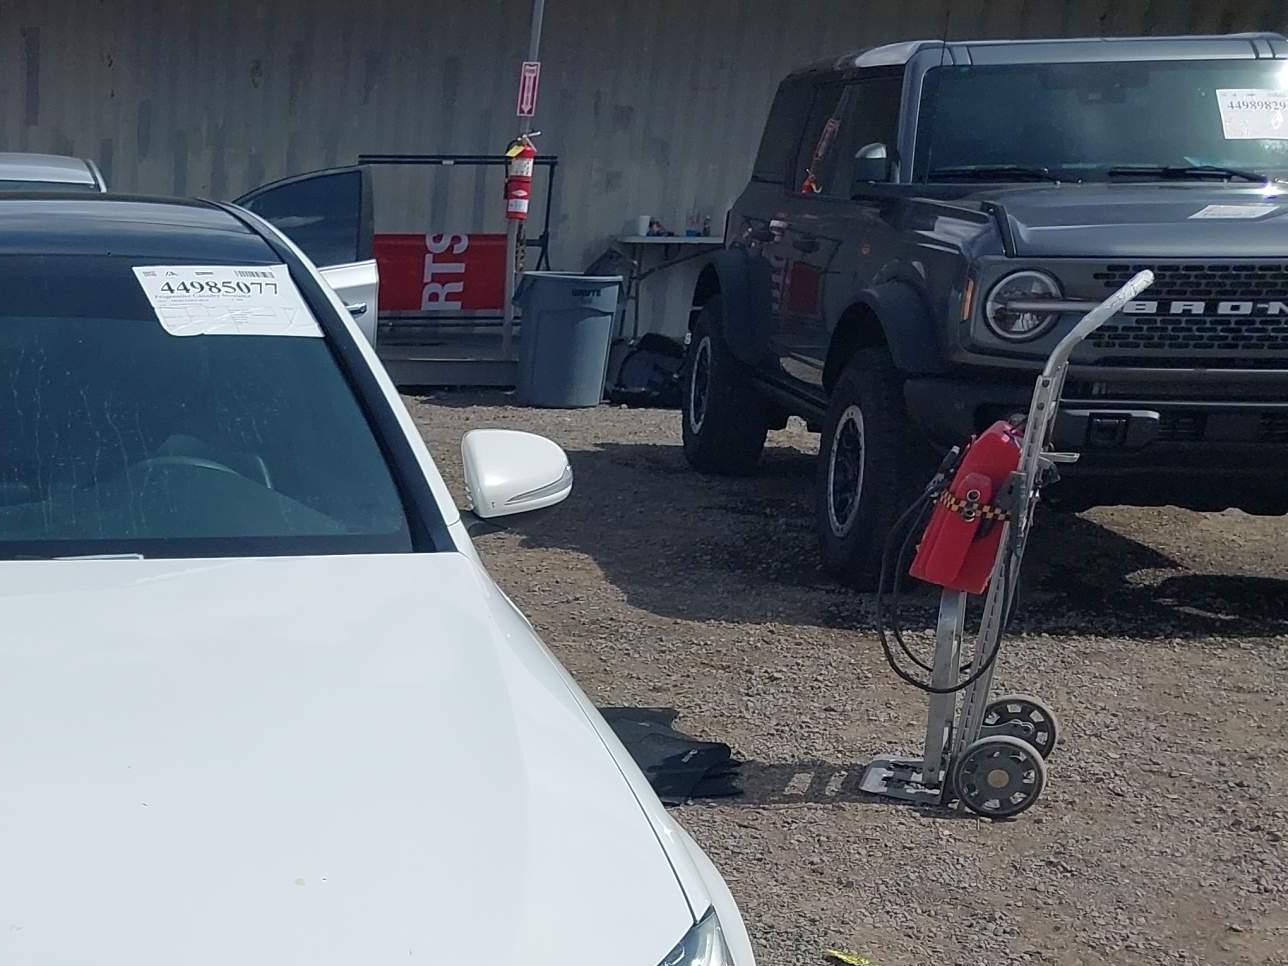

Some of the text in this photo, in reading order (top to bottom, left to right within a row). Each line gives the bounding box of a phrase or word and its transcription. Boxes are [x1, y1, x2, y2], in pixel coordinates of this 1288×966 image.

[1227, 101, 1287, 111] 44989829
[421, 233, 469, 311] RTS
[160, 280, 278, 295] 44985077
